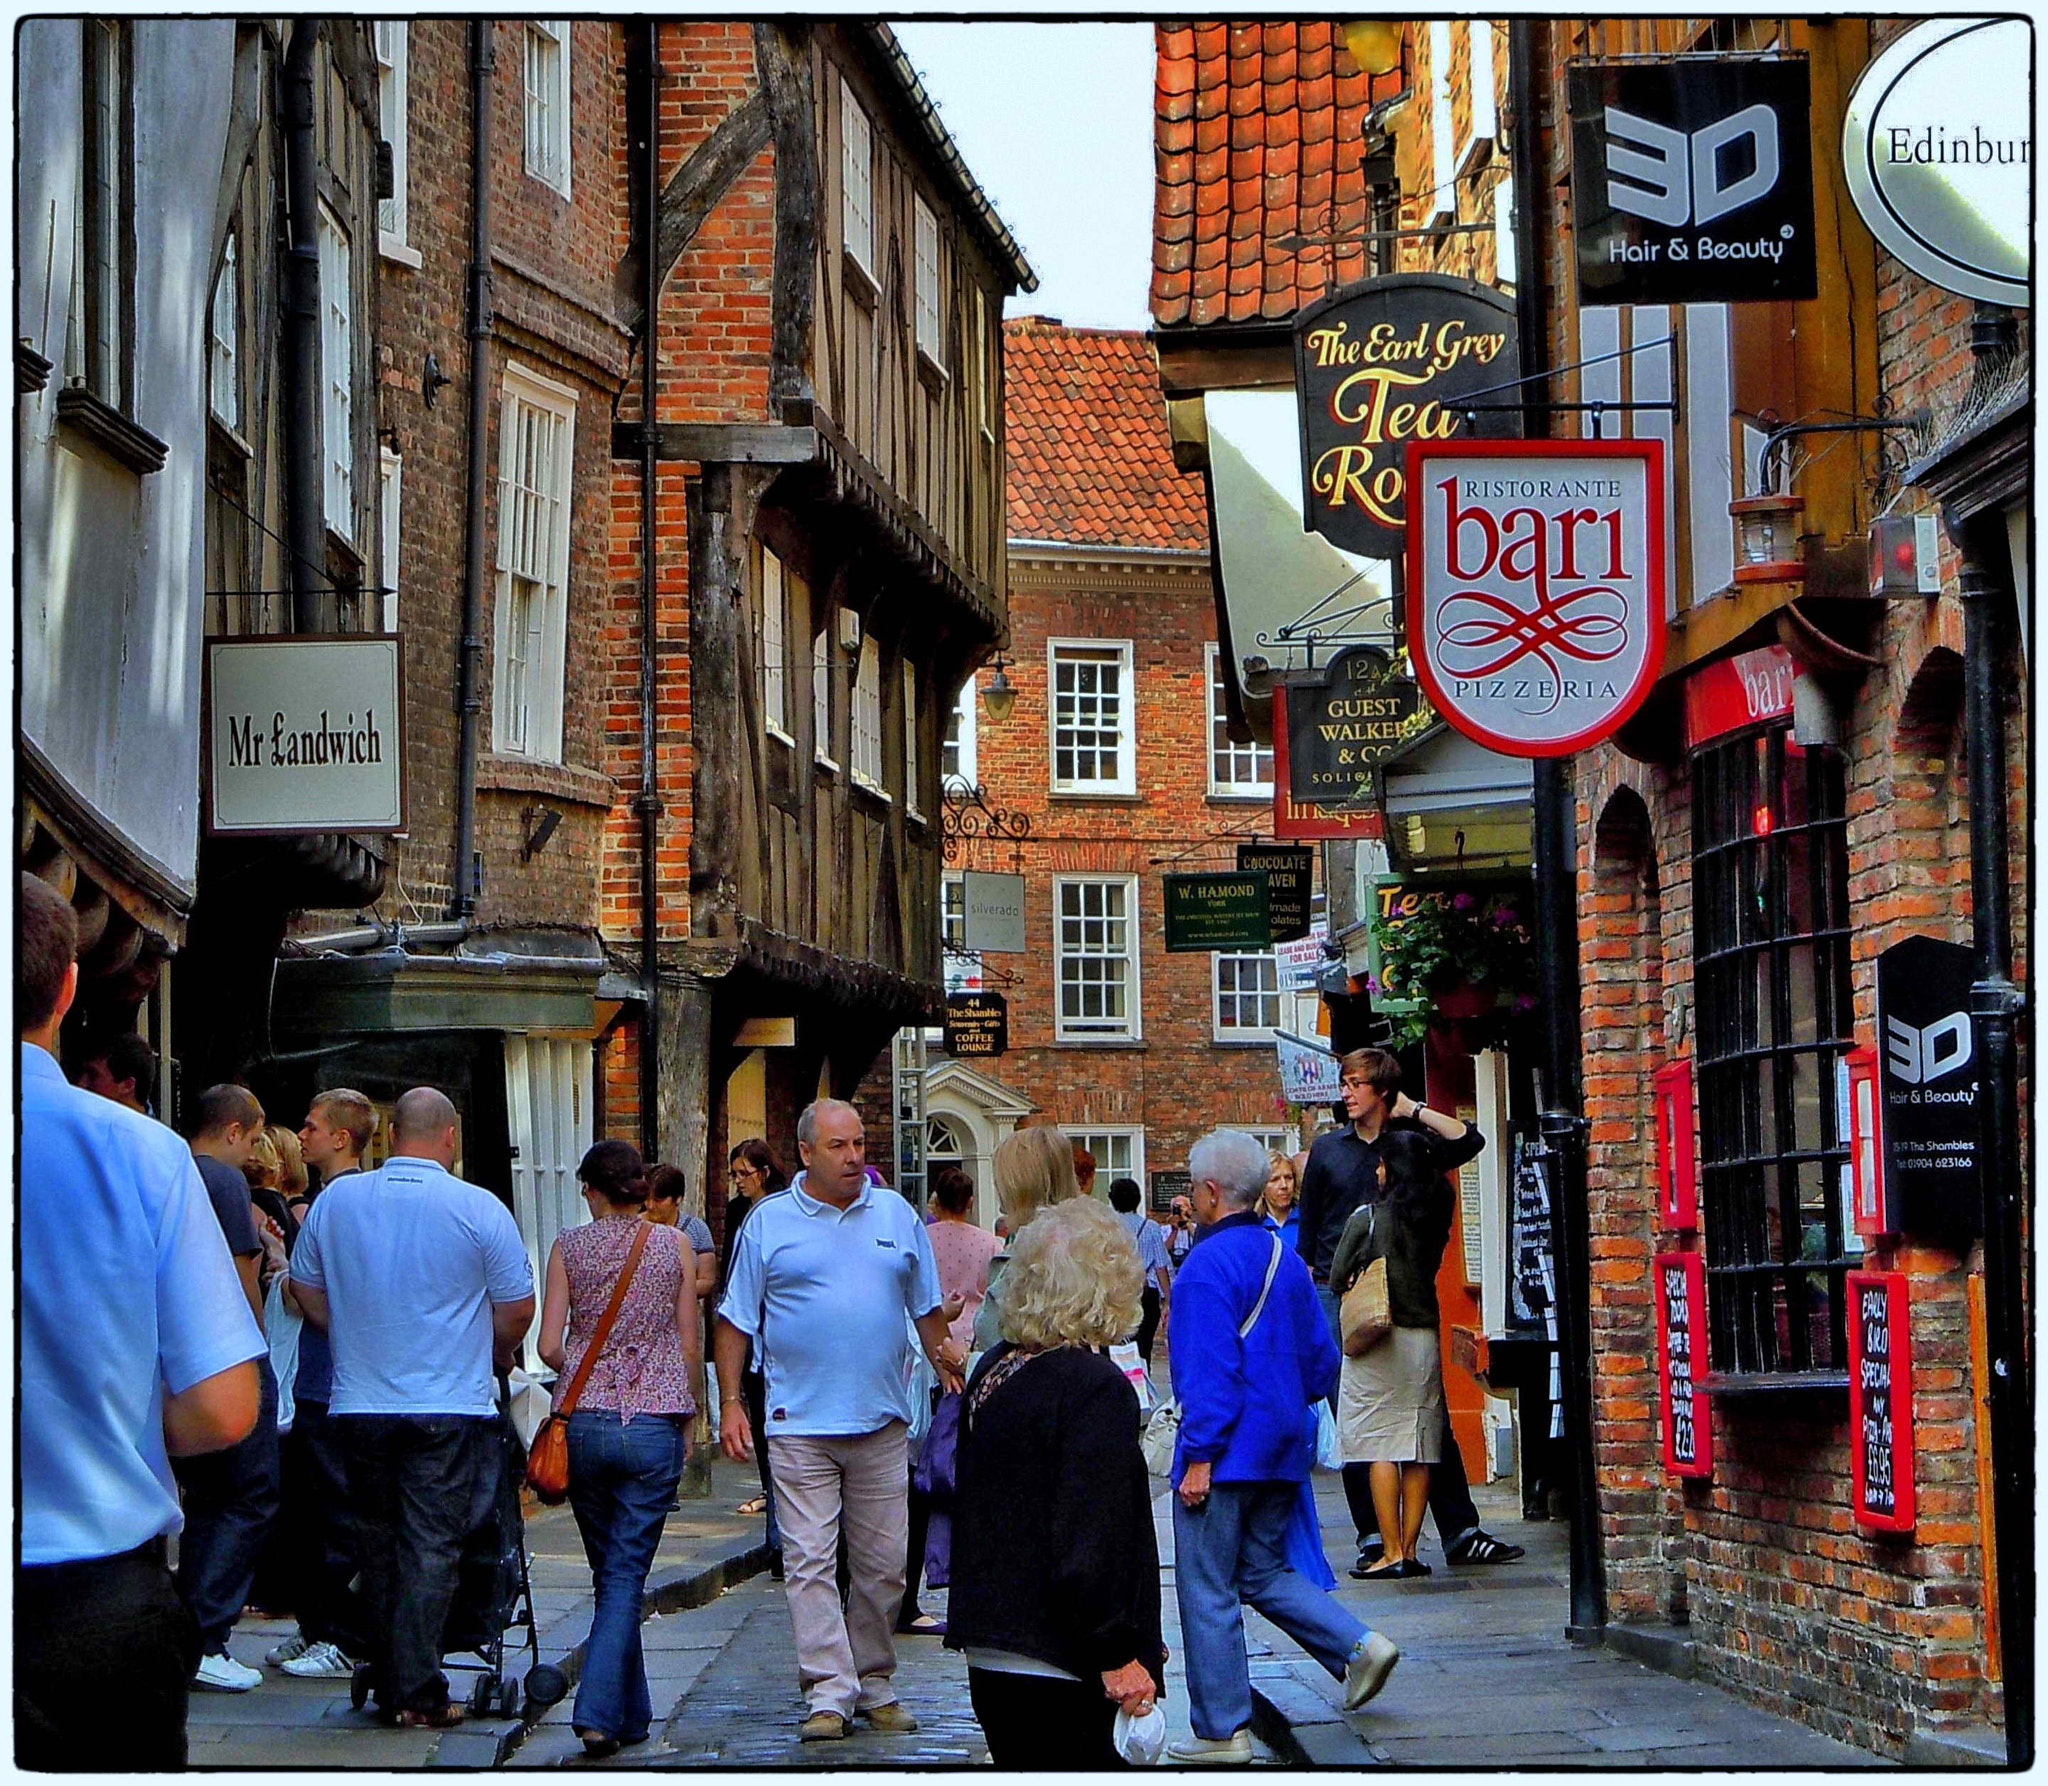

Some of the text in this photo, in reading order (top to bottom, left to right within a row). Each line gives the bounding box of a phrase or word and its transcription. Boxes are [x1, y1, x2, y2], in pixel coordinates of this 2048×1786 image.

[1604, 103, 1780, 228] 3D
[1609, 235, 1784, 264] Hair & Beauty
[1307, 319, 1506, 372] The Earl Grey
[1332, 367, 1461, 444] Tea
[1311, 445, 1407, 526] Ro
[1465, 480, 1622, 498] RISTORANTE
[1436, 475, 1633, 581] bari
[1454, 681, 1618, 699] PIZZERIA
[1741, 659, 1794, 718] bar
[1327, 698, 1400, 718] GUEST
[228, 715, 265, 767] Mr
[1318, 722, 1412, 742] WALKER
[1338, 748, 1355, 764] &
[1243, 856, 1307, 870] CHOCOLATE
[1268, 873, 1297, 888] AVEN
[1178, 884, 1255, 899] W. HAMOND
[971, 903, 1019, 917] silverado
[1207, 900, 1227, 908] YORK
[1269, 902, 1301, 913] made
[1377, 885, 1420, 918] Te
[1289, 953, 1302, 964] FOR
[967, 998, 981, 1008] 44
[947, 1007, 1002, 1018] The Shambles
[955, 1033, 995, 1043] COFFEE
[956, 1043, 994, 1052] LOUNGE
[1887, 1011, 1972, 1084] 3D
[1890, 1089, 1974, 1105] Hair & Beauty
[1909, 1141, 1925, 1152] The
[1926, 1139, 1975, 1151] Shambles
[1934, 1156, 1973, 1169] 623166
[1862, 1290, 1888, 1323] EARLY
[1860, 1357, 1891, 1390] SPECIAL
